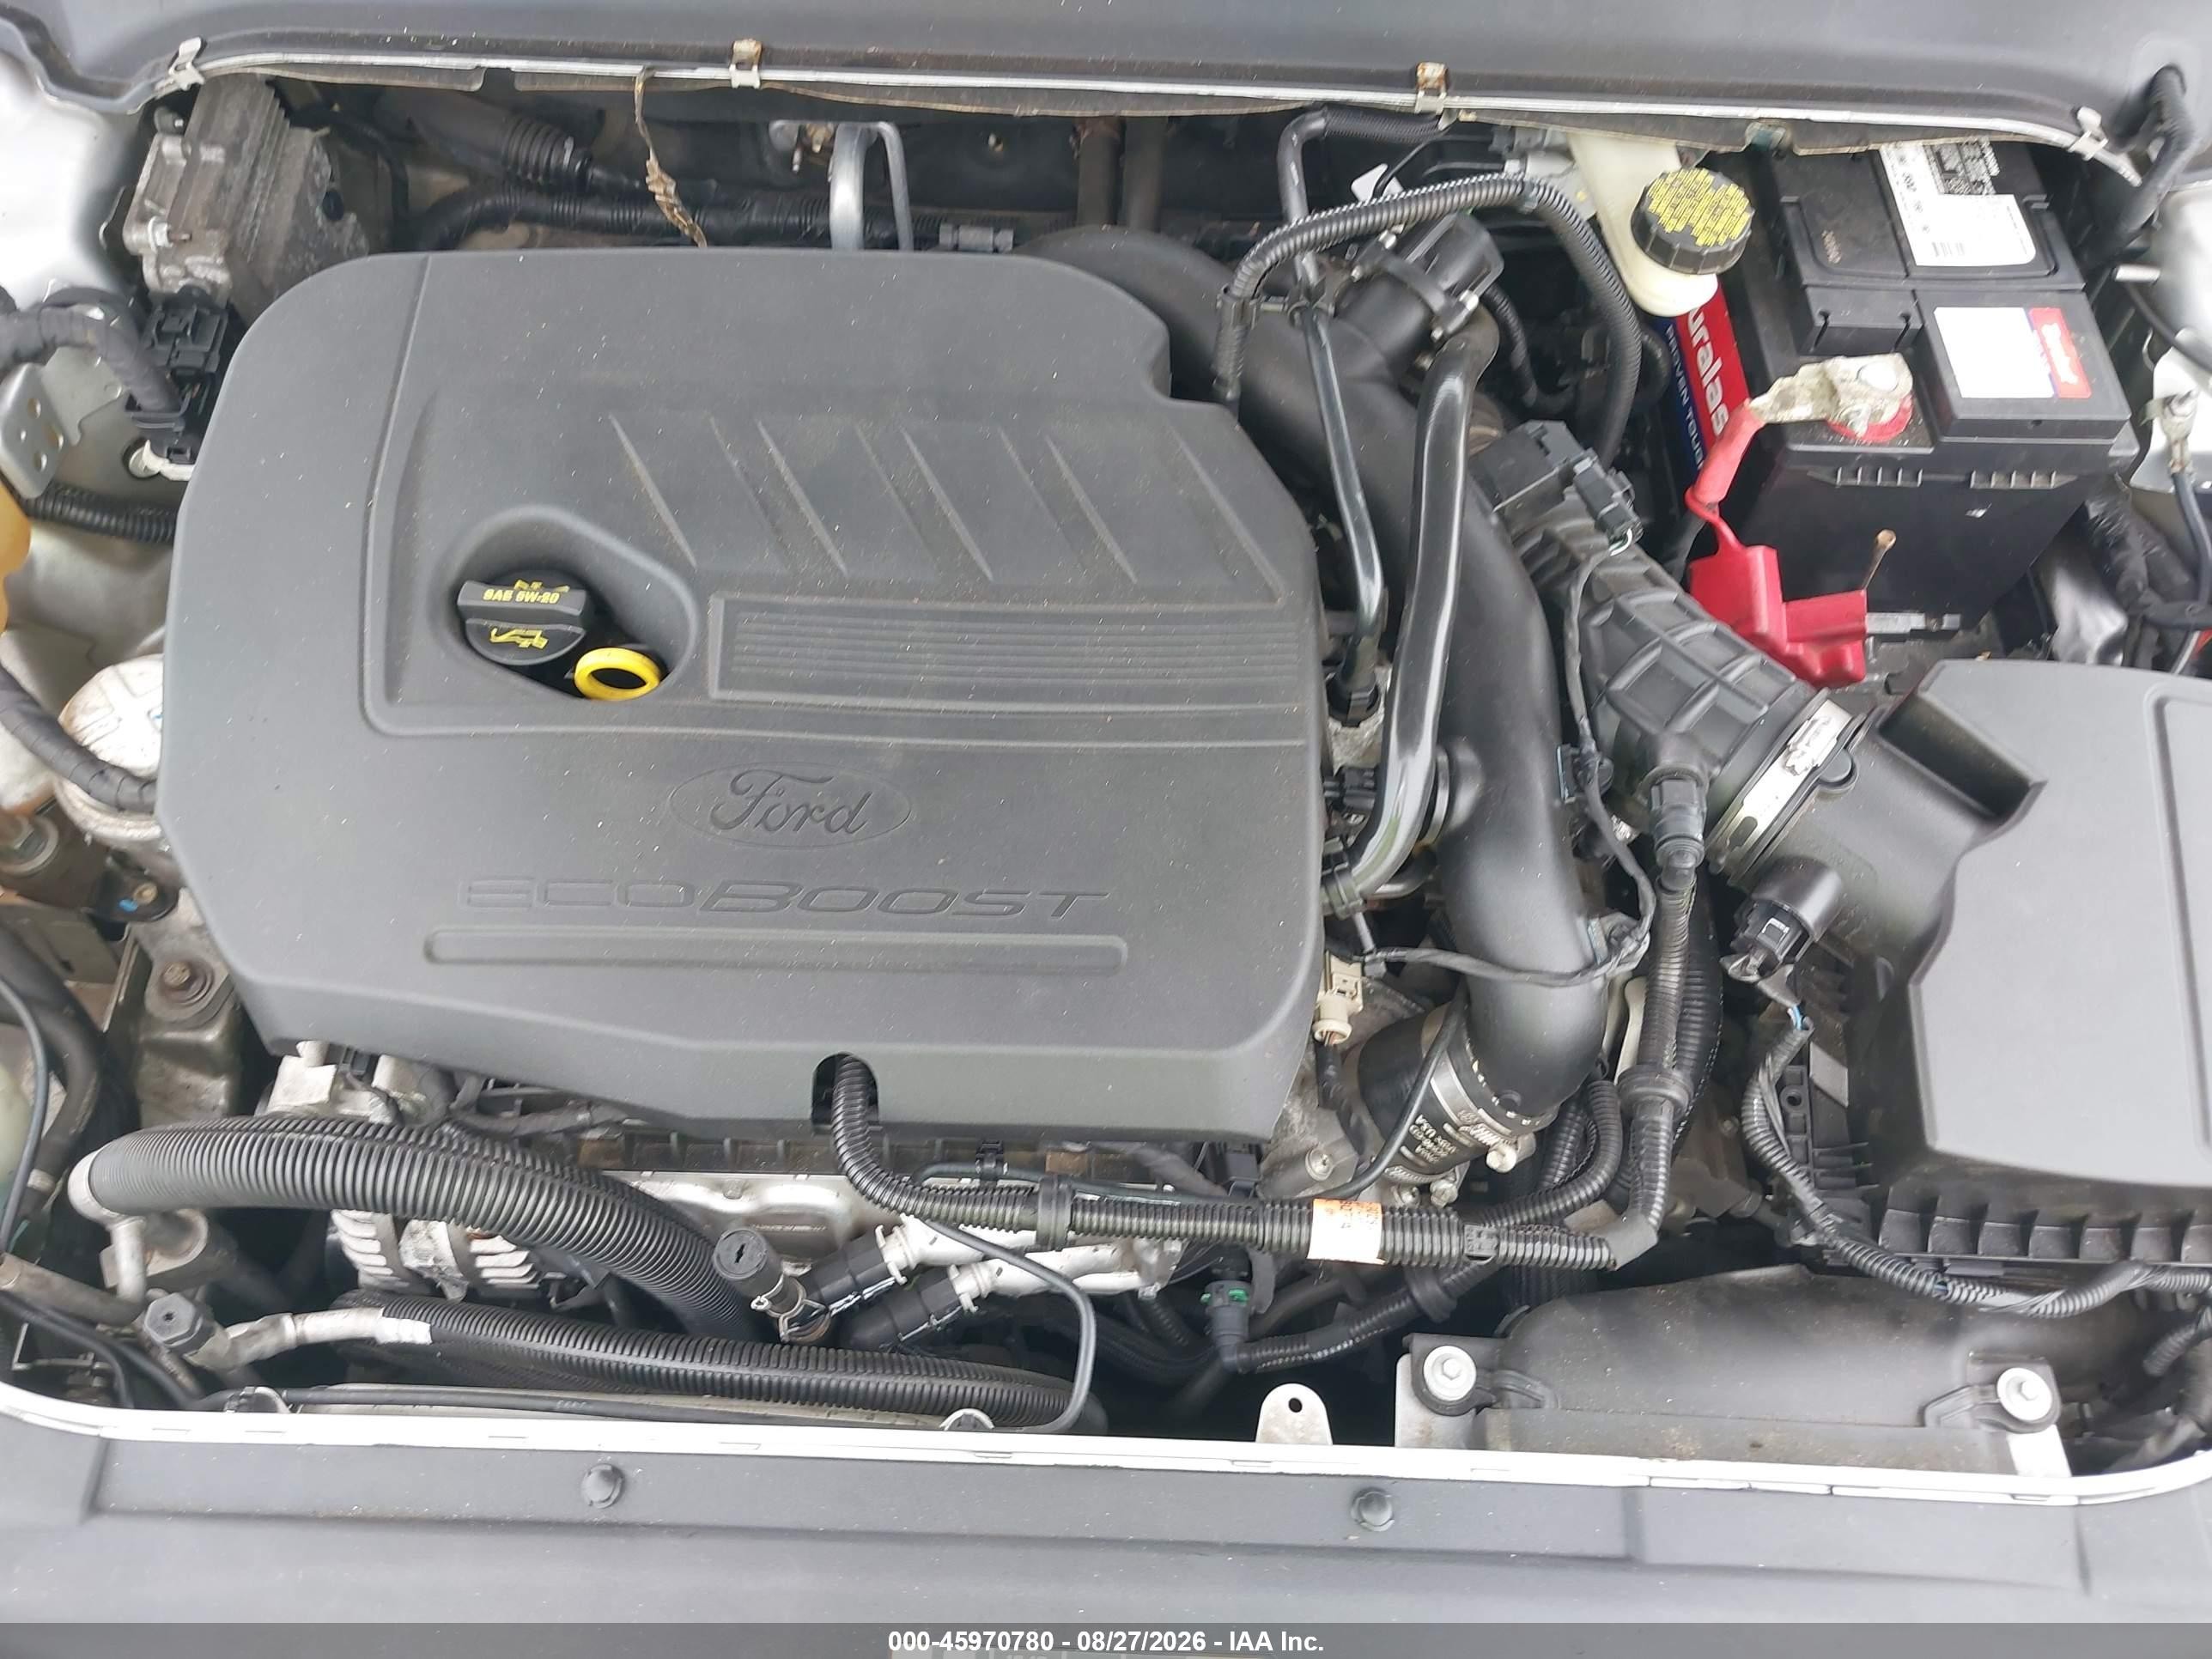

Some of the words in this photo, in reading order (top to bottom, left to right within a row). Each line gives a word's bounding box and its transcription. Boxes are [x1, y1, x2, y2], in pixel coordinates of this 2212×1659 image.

[1666, 324, 1690, 407] PROVEN
[1687, 307, 1730, 437] uralas
[483, 588, 514, 601] SAE
[515, 589, 560, 605] 5W-20
[709, 769, 873, 835] Ford
[460, 876, 1110, 921] ECOBOOST
